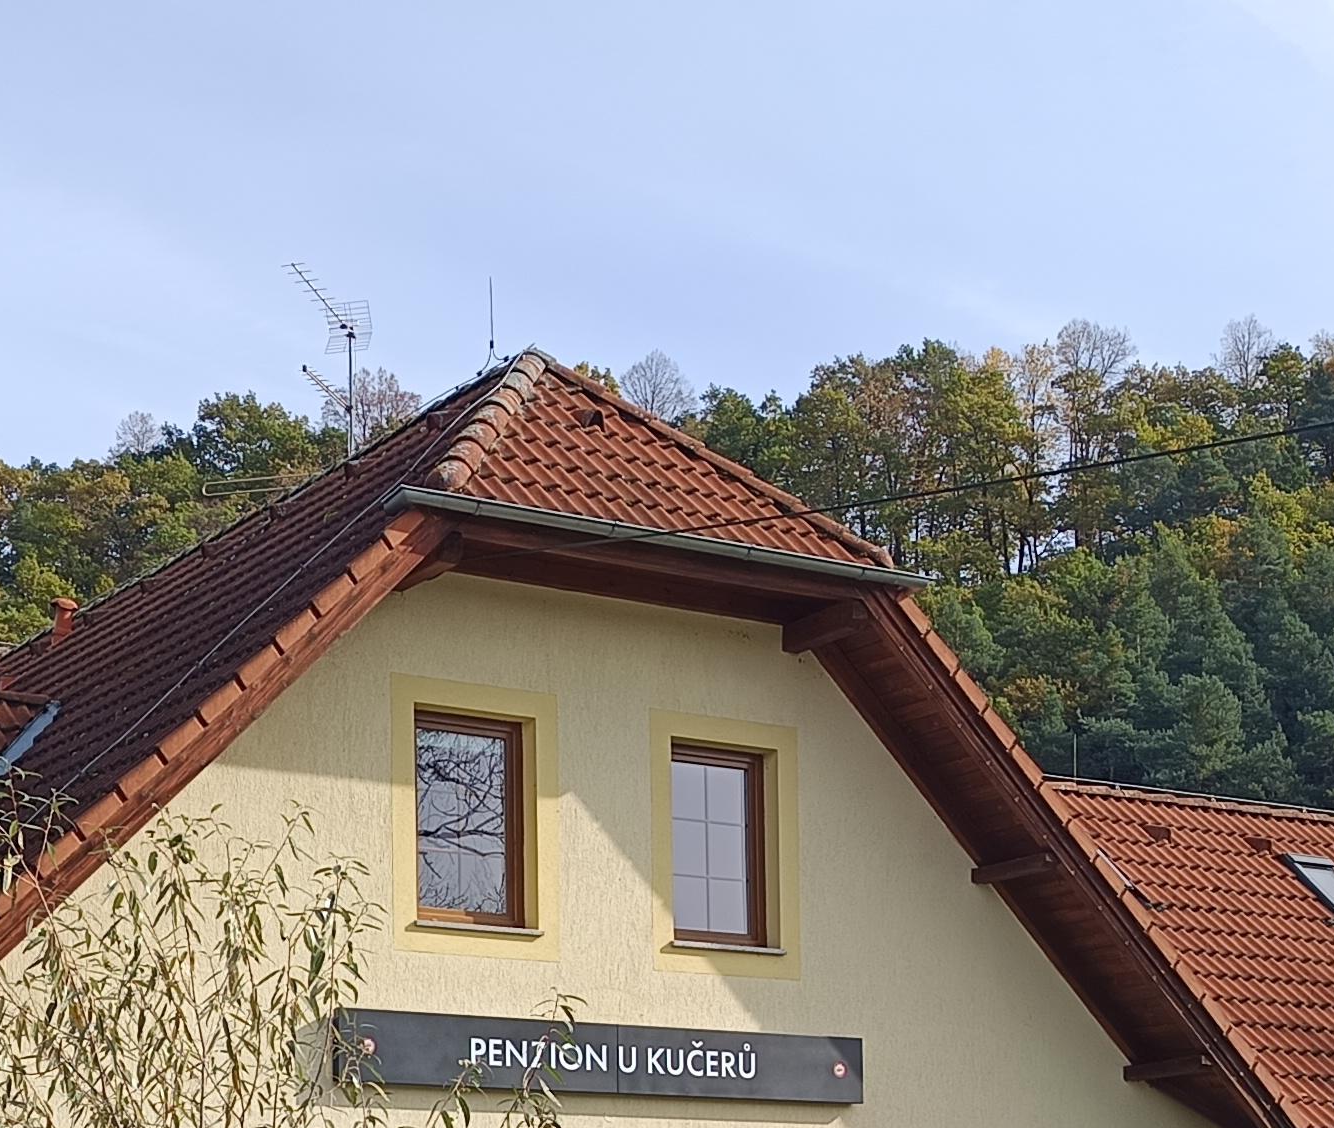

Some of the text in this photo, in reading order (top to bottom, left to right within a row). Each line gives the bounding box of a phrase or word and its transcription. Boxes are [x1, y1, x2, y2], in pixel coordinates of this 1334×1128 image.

[470, 1037, 757, 1079] PENZION U KUČERŮ
